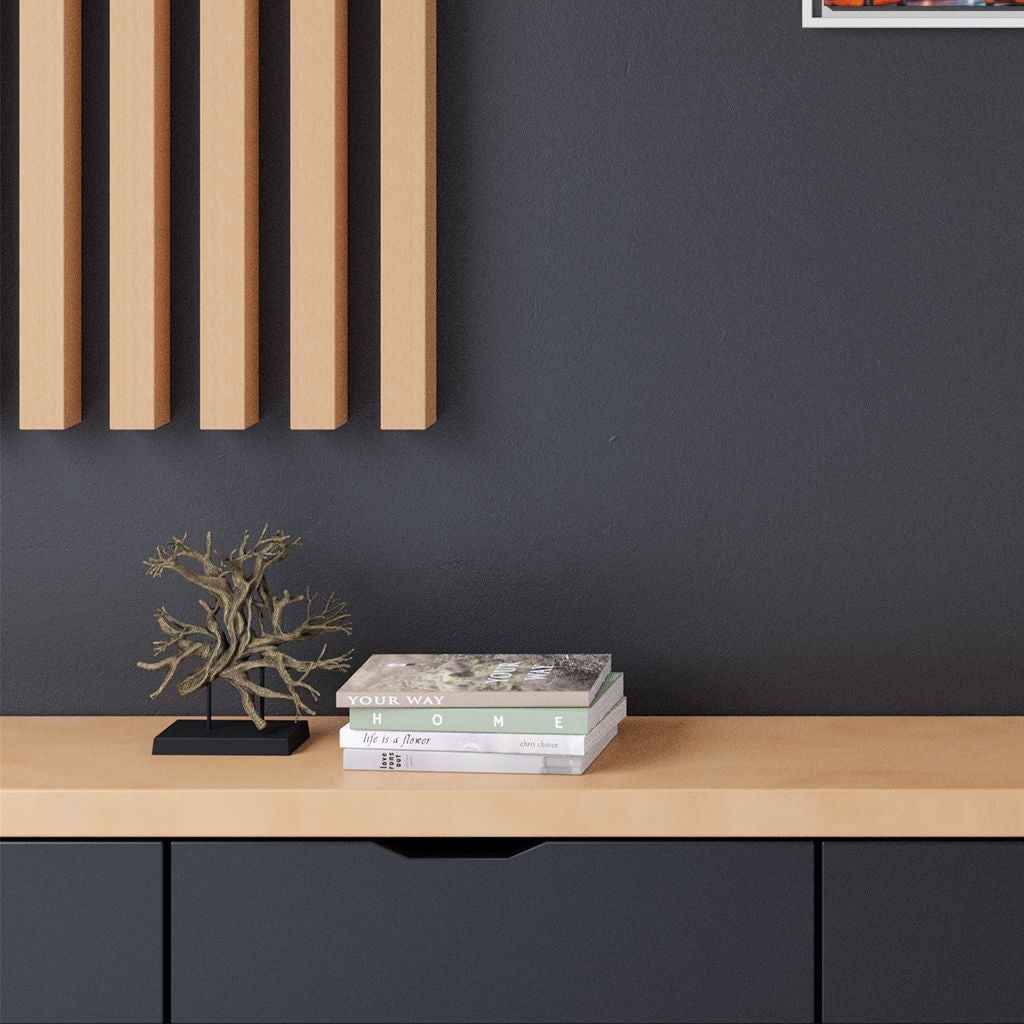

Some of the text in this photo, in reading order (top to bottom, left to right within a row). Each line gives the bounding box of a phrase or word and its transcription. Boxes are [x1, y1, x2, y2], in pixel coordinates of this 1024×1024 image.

[347, 695, 446, 705] YOUR WAY
[363, 732, 431, 748] life is a flower
[520, 739, 559, 749] chris choice
